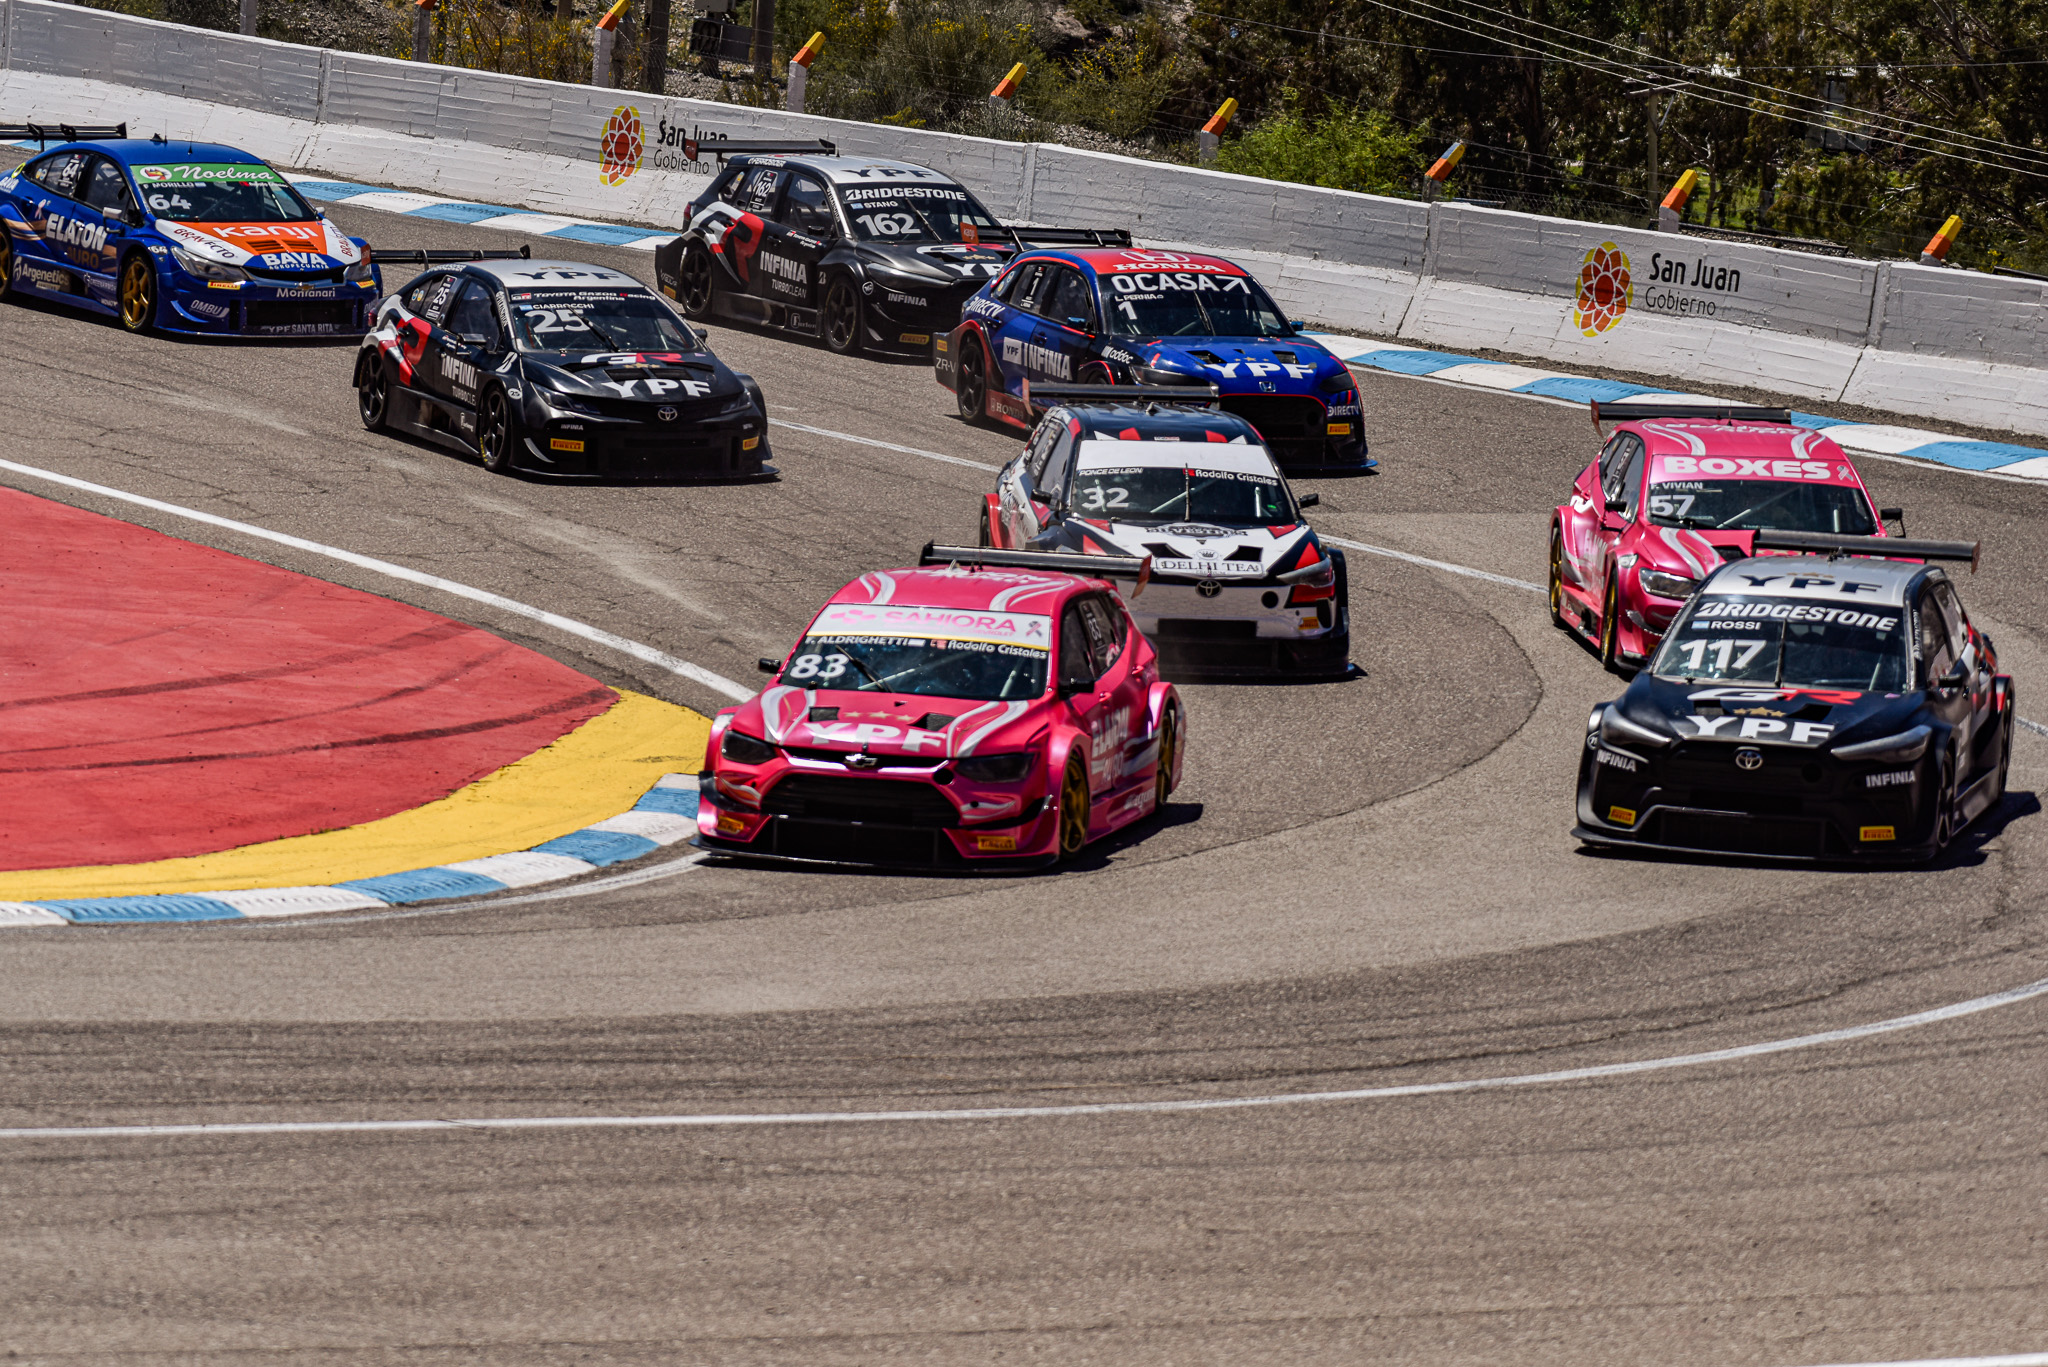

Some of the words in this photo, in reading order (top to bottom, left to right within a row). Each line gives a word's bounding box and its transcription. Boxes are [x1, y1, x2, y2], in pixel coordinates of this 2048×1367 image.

[657, 119, 686, 147] San
[62, 162, 80, 177] 64
[654, 149, 710, 175] Gobierno
[173, 165, 275, 181] Noelma
[841, 168, 933, 178] YPF
[152, 181, 195, 189] MORILLO
[756, 181, 772, 197] 162
[846, 187, 967, 201] BRIDGESTONE
[149, 193, 192, 210] 64
[863, 201, 899, 209] STANG
[212, 225, 318, 239] kanji
[856, 213, 922, 236] 162
[261, 252, 328, 266] BAVA
[759, 250, 808, 285] INFINIA
[1113, 262, 1226, 273] HONDA
[512, 271, 620, 280] YPF
[943, 263, 1005, 276] YP
[1648, 252, 1686, 284] San
[1690, 258, 1740, 292] Juan
[771, 279, 807, 299] TURBOCLEAN
[1111, 272, 1220, 293] OCASA
[433, 287, 450, 305] 25
[887, 293, 928, 307] INFINIA
[1645, 286, 1716, 316] Gobierno
[191, 300, 222, 316] OMBU
[965, 296, 1006, 318] DIRECTV
[1118, 300, 1138, 321] 1
[268, 325, 291, 333] YPF
[292, 323, 315, 334] SANTA
[317, 323, 334, 333] RITA
[524, 309, 591, 333] 25
[935, 357, 957, 373] ZR-V
[1006, 344, 1020, 356] YPF
[1023, 342, 1073, 381] INFINIA
[1204, 362, 1315, 379] YPF
[601, 378, 712, 398] YPF
[1328, 405, 1359, 417] DIRECTV
[1079, 468, 1108, 477] PONCE
[1120, 467, 1144, 475] LEON
[1663, 456, 1832, 480] BOXES
[1195, 469, 1235, 480] Rodolfo
[1236, 472, 1279, 487] Cristales
[1662, 481, 1704, 490] VIVIAN
[1081, 487, 1130, 509] 32
[1650, 494, 1696, 517] 57
[1163, 560, 1218, 571] DELHI
[1222, 562, 1256, 572] TEA
[1739, 574, 1882, 593] YPF
[883, 610, 1016, 633] SAHIORA
[1694, 602, 1898, 632] BRIDGESTONE
[1710, 620, 1761, 631] ROSSI
[818, 635, 908, 646] ALDRIGHETTI
[948, 639, 996, 653] Rodolfo
[997, 644, 1048, 660] Cristales
[1679, 638, 1767, 673] 117
[790, 653, 850, 679] 83
[803, 722, 948, 752] YPF
[1686, 714, 1835, 743] YPF
[1866, 770, 1916, 788] INFINIA
